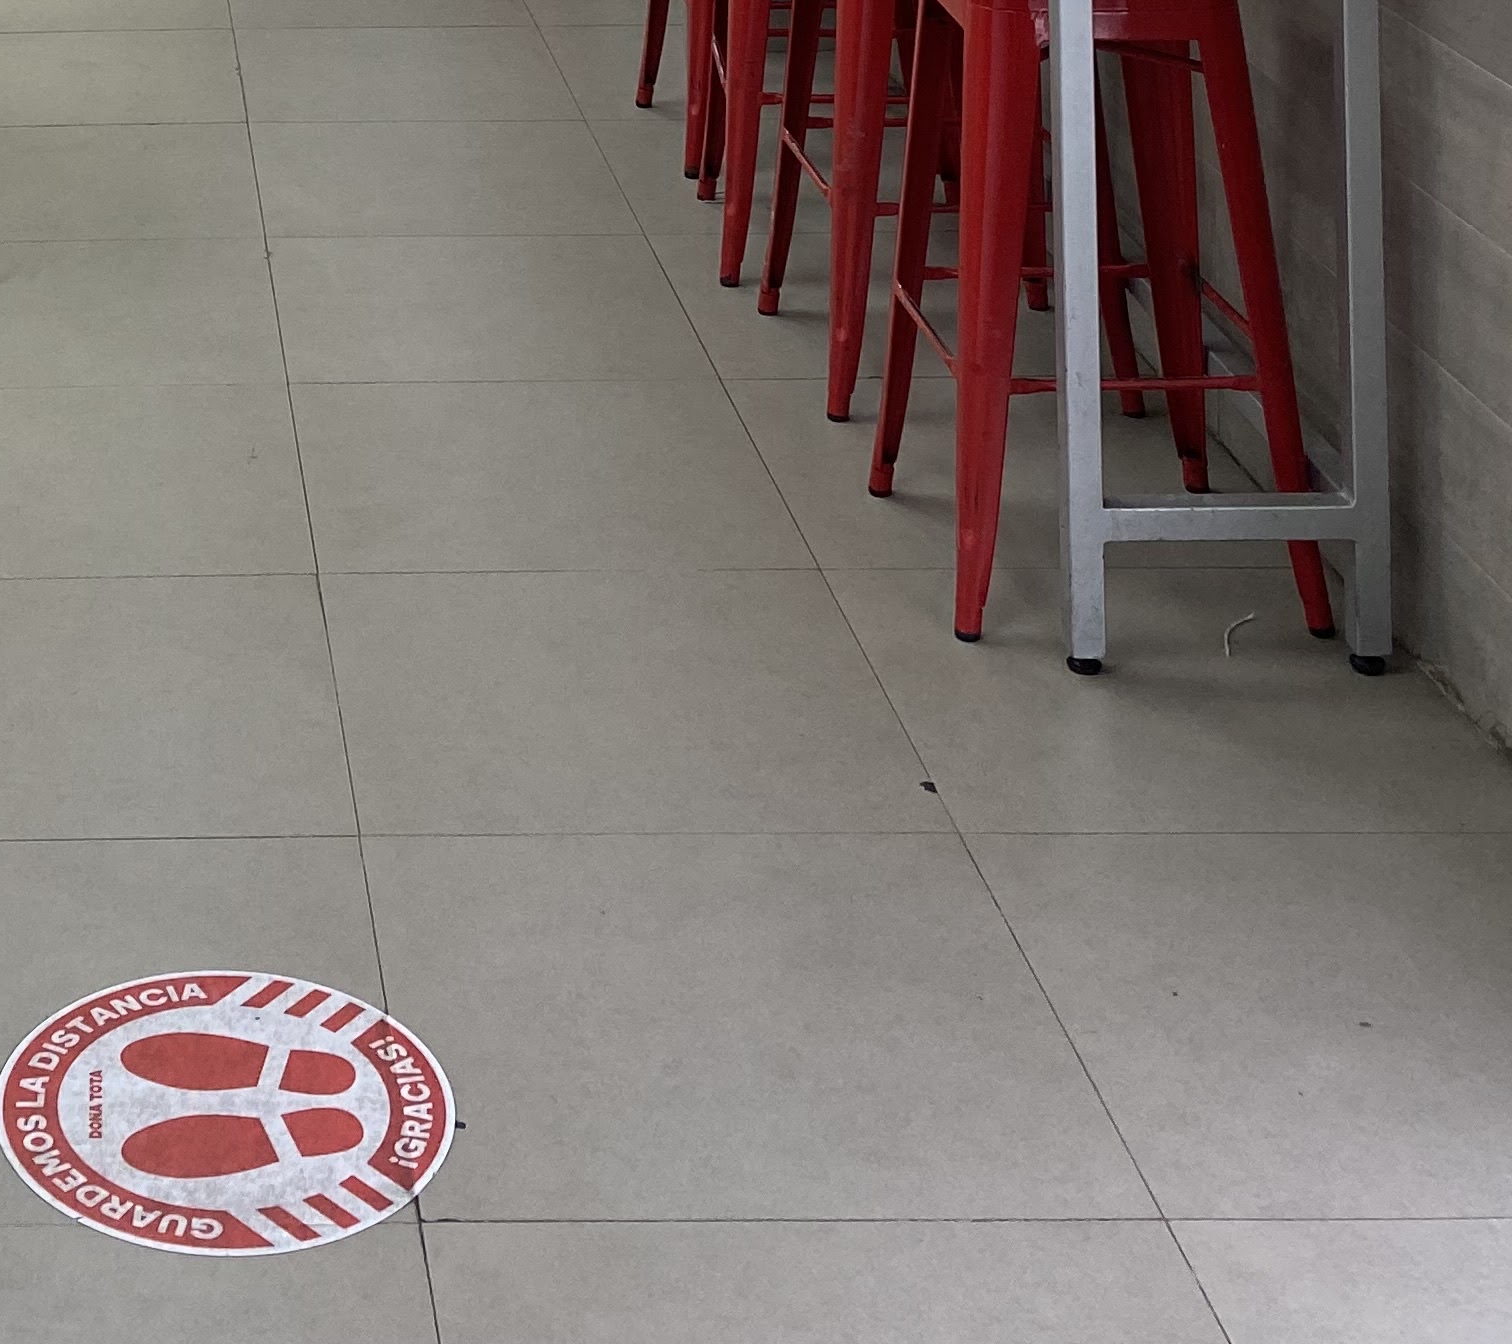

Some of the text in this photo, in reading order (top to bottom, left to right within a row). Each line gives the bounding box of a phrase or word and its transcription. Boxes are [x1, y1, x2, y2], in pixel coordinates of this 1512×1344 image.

[15, 982, 224, 1240] GUARDEMOS LA DISTANCIA
[88, 1069, 103, 1102] TOTA
